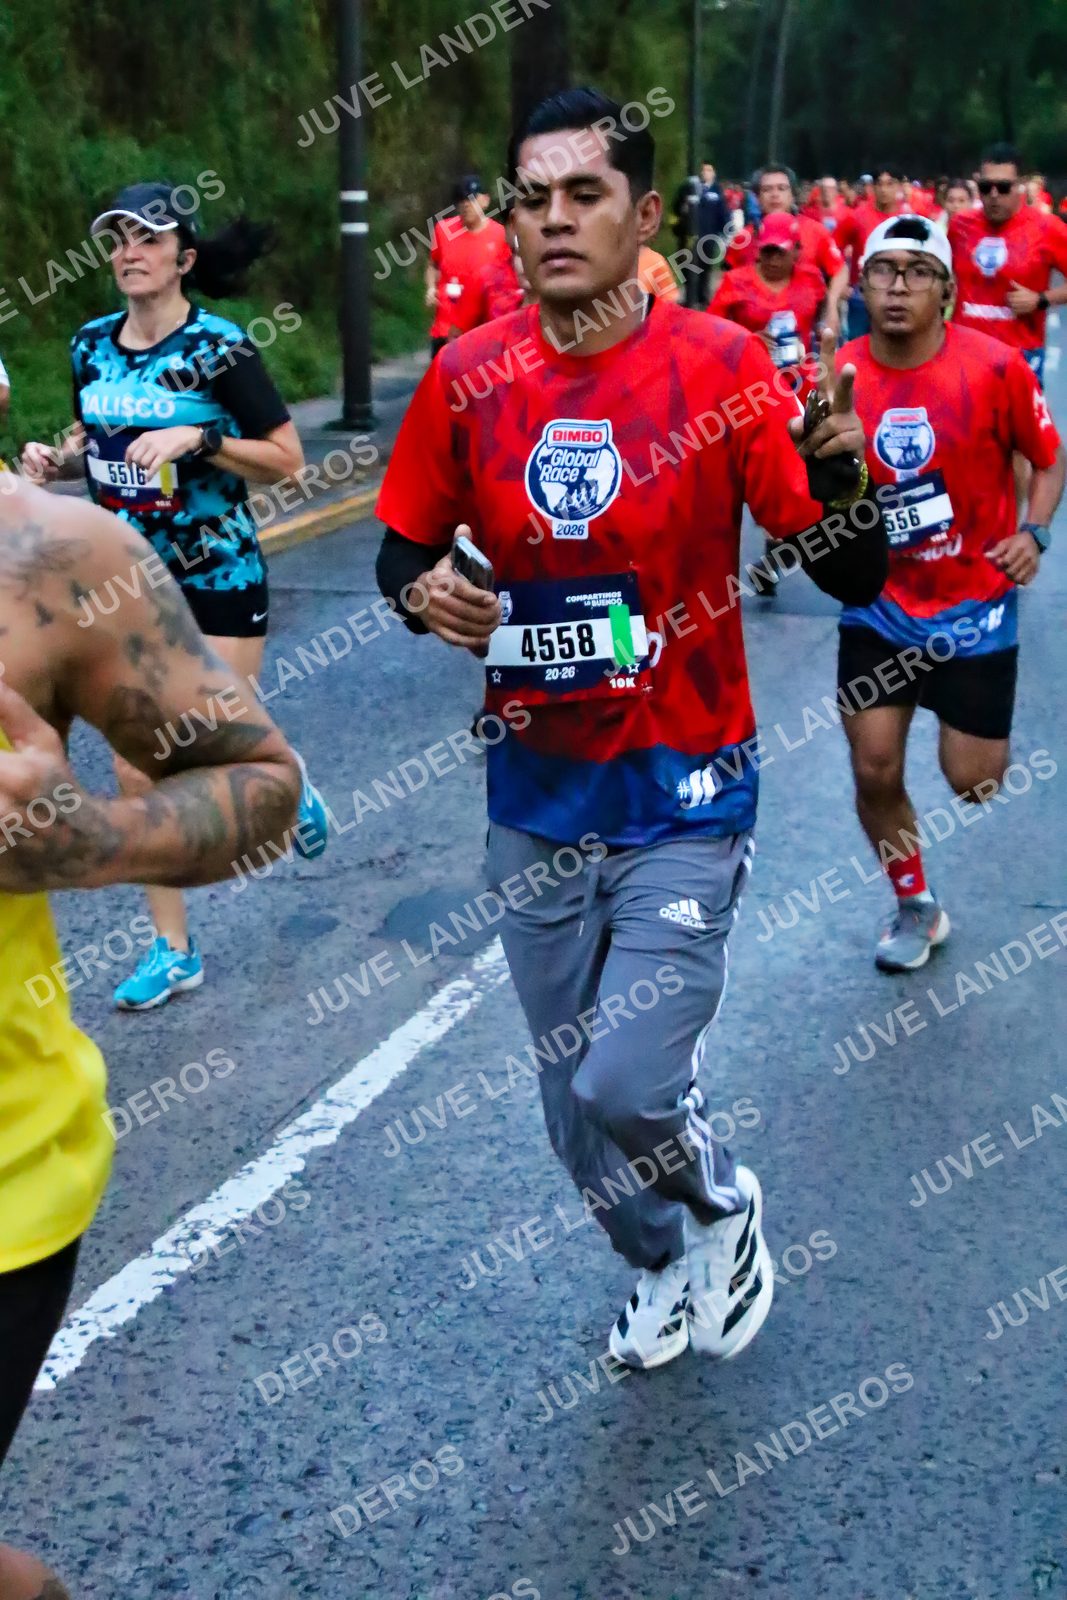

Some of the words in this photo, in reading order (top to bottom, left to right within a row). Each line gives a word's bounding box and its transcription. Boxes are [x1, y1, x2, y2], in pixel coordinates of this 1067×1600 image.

[553, 430, 602, 442] BIMBO
[551, 448, 600, 468] Global
[541, 464, 580, 482] Race
[556, 523, 585, 536] 2026
[522, 623, 596, 662] 4558
[545, 666, 576, 681] 20-26
[610, 677, 636, 689] 10K
